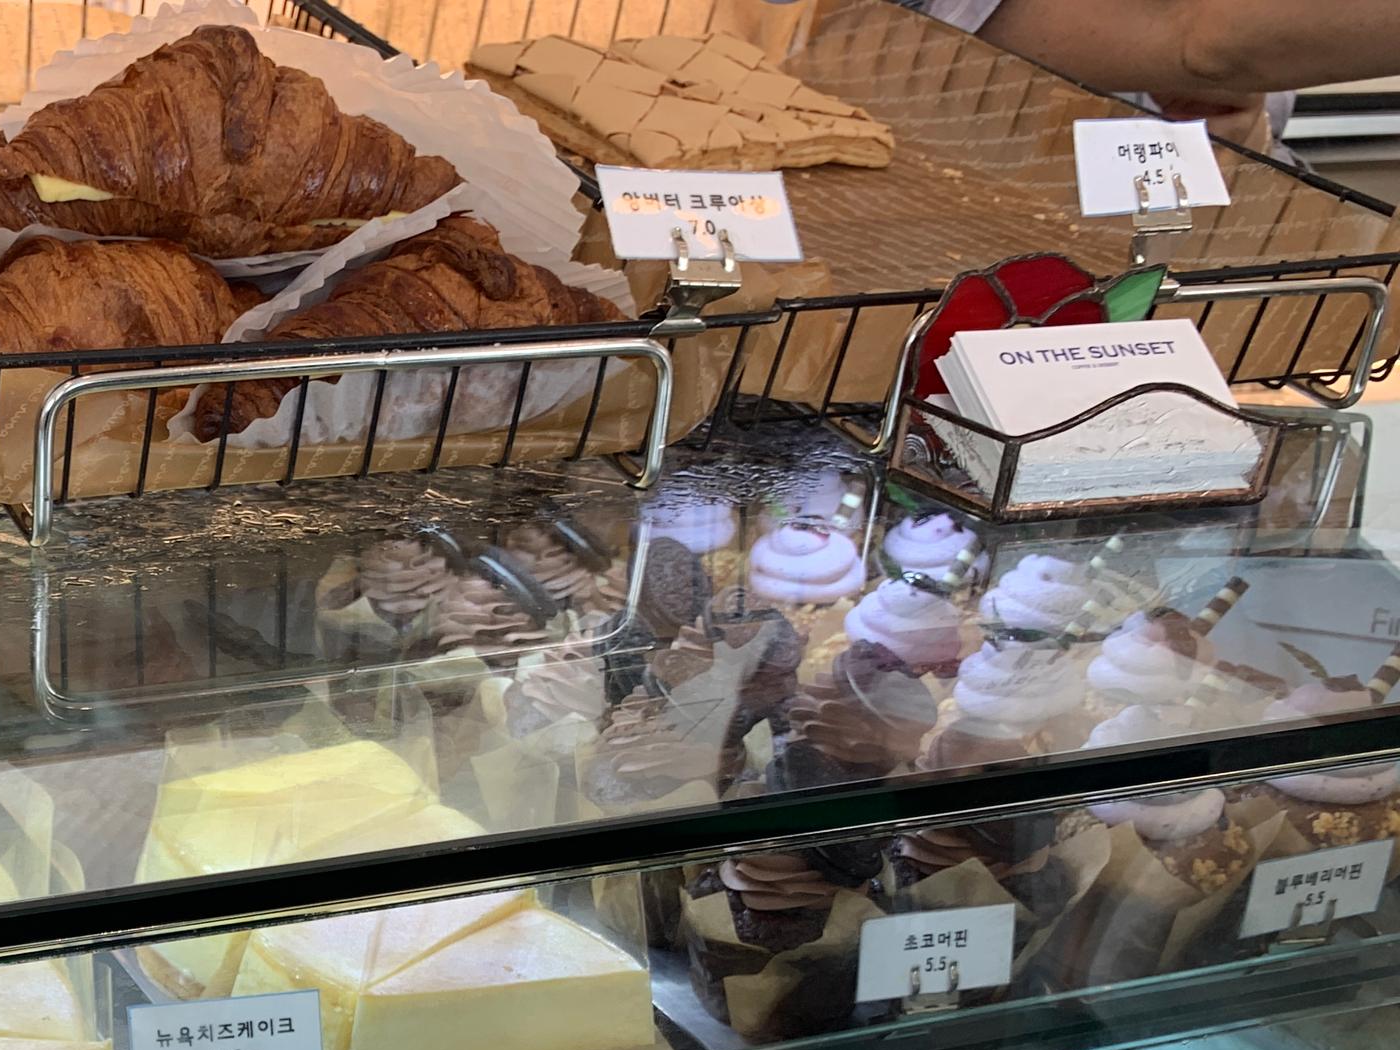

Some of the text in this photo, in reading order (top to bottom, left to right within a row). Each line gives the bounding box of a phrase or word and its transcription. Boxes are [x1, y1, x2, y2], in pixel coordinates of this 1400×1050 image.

[1143, 169, 1164, 185] 4.5
[622, 191, 682, 212] 앙버터
[688, 219, 716, 236] 7.0
[999, 340, 1176, 366] ON THE SUNSET
[1274, 862, 1364, 896] 블루베리머핀
[1303, 890, 1326, 907] 5.5
[903, 929, 968, 951] 초코머핀
[924, 956, 947, 973] 5.5
[156, 1017, 295, 1048] 뉴욕치즈케이크
